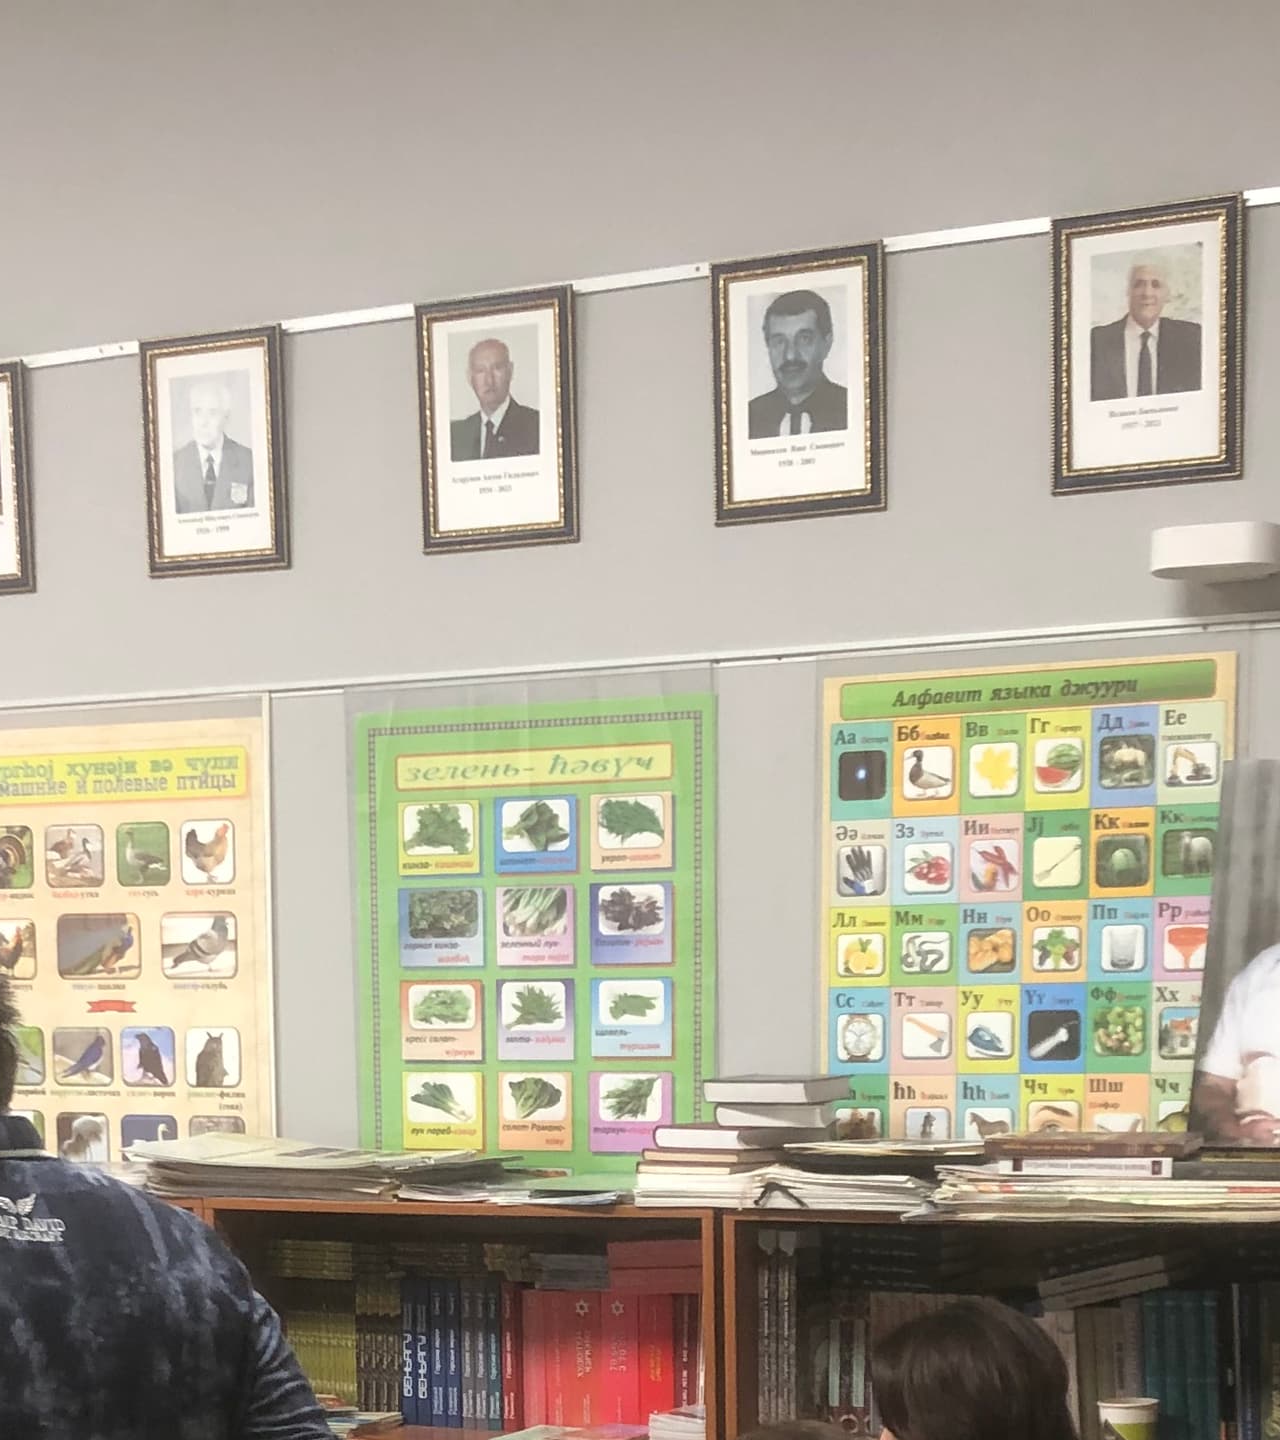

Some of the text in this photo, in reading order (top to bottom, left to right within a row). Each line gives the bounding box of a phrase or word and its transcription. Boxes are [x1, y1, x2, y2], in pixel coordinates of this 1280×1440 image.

[892, 679, 1138, 709] Алфавит языка джуури
[1030, 718, 1050, 733] Гг
[1098, 714, 1124, 731] Дд
[1164, 709, 1187, 726] Ее
[835, 730, 856, 745] Аа
[897, 725, 920, 742] Бб
[965, 722, 989, 738] Вв
[76, 778, 88, 794] и
[93, 775, 168, 793] полевые
[177, 772, 237, 792] птицы
[964, 820, 989, 836] Ии
[1094, 814, 1120, 830] Кк
[895, 823, 915, 839] Зз
[832, 912, 857, 928] Лл
[895, 911, 923, 926] Мм
[962, 909, 988, 924] Нн
[1026, 906, 1051, 922] Оо
[1092, 904, 1118, 920] Пп
[1158, 902, 1182, 922] Рр
[836, 993, 855, 1008] Сс
[894, 992, 916, 1007] Тт
[961, 990, 984, 1010] Уу
[1091, 986, 1117, 1003] Фф
[1155, 986, 1180, 1002] Хх
[1089, 1079, 1123, 1093] Шш
[21, 1216, 66, 1231] DAVID
